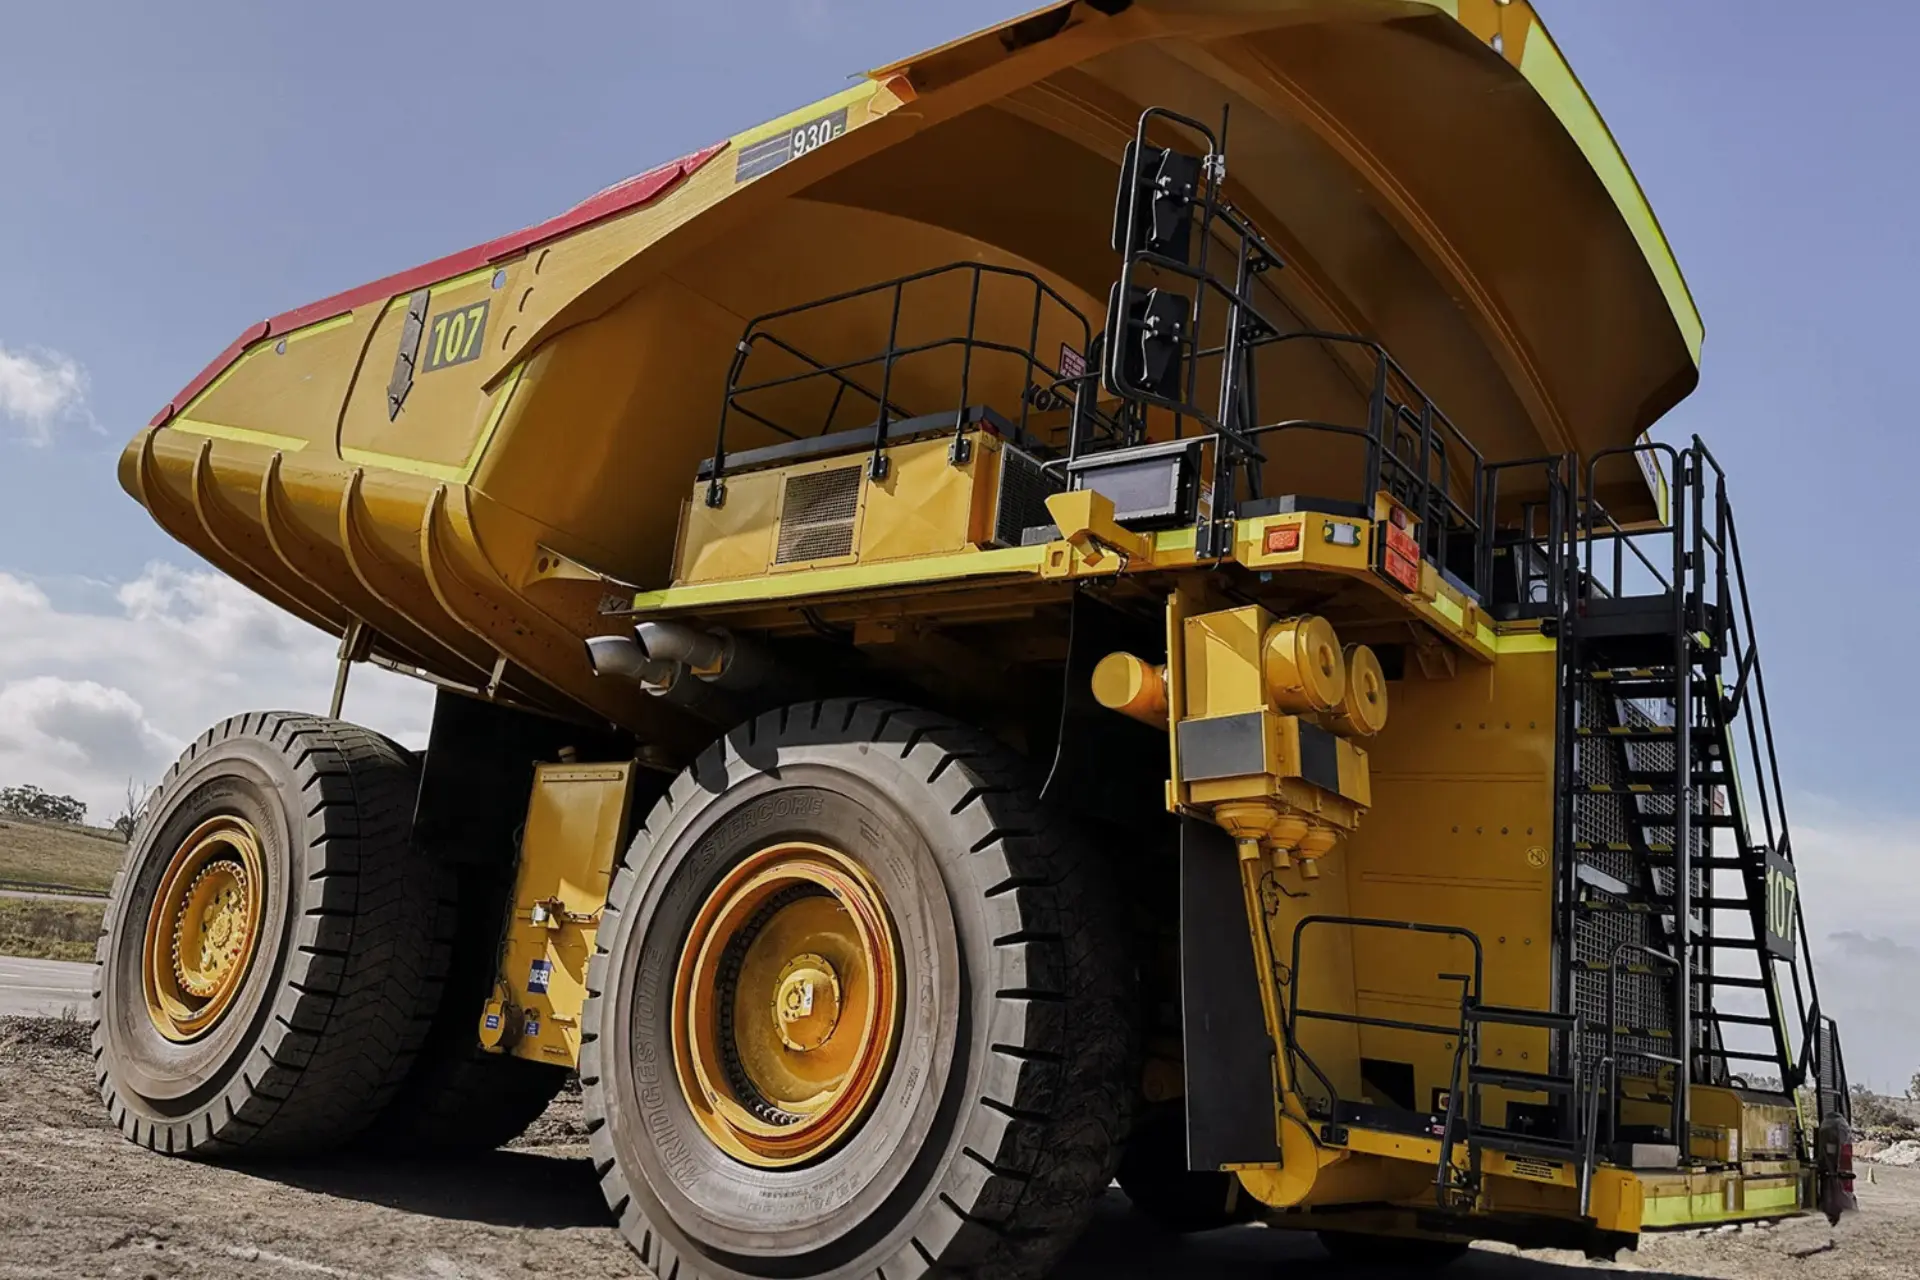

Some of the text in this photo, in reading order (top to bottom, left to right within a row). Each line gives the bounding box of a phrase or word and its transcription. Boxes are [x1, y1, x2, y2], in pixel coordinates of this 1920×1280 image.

[793, 119, 843, 158] 930E
[432, 306, 485, 367] 107
[1767, 865, 1796, 942] 107
[635, 948, 700, 1190] BRIDGESTONE
